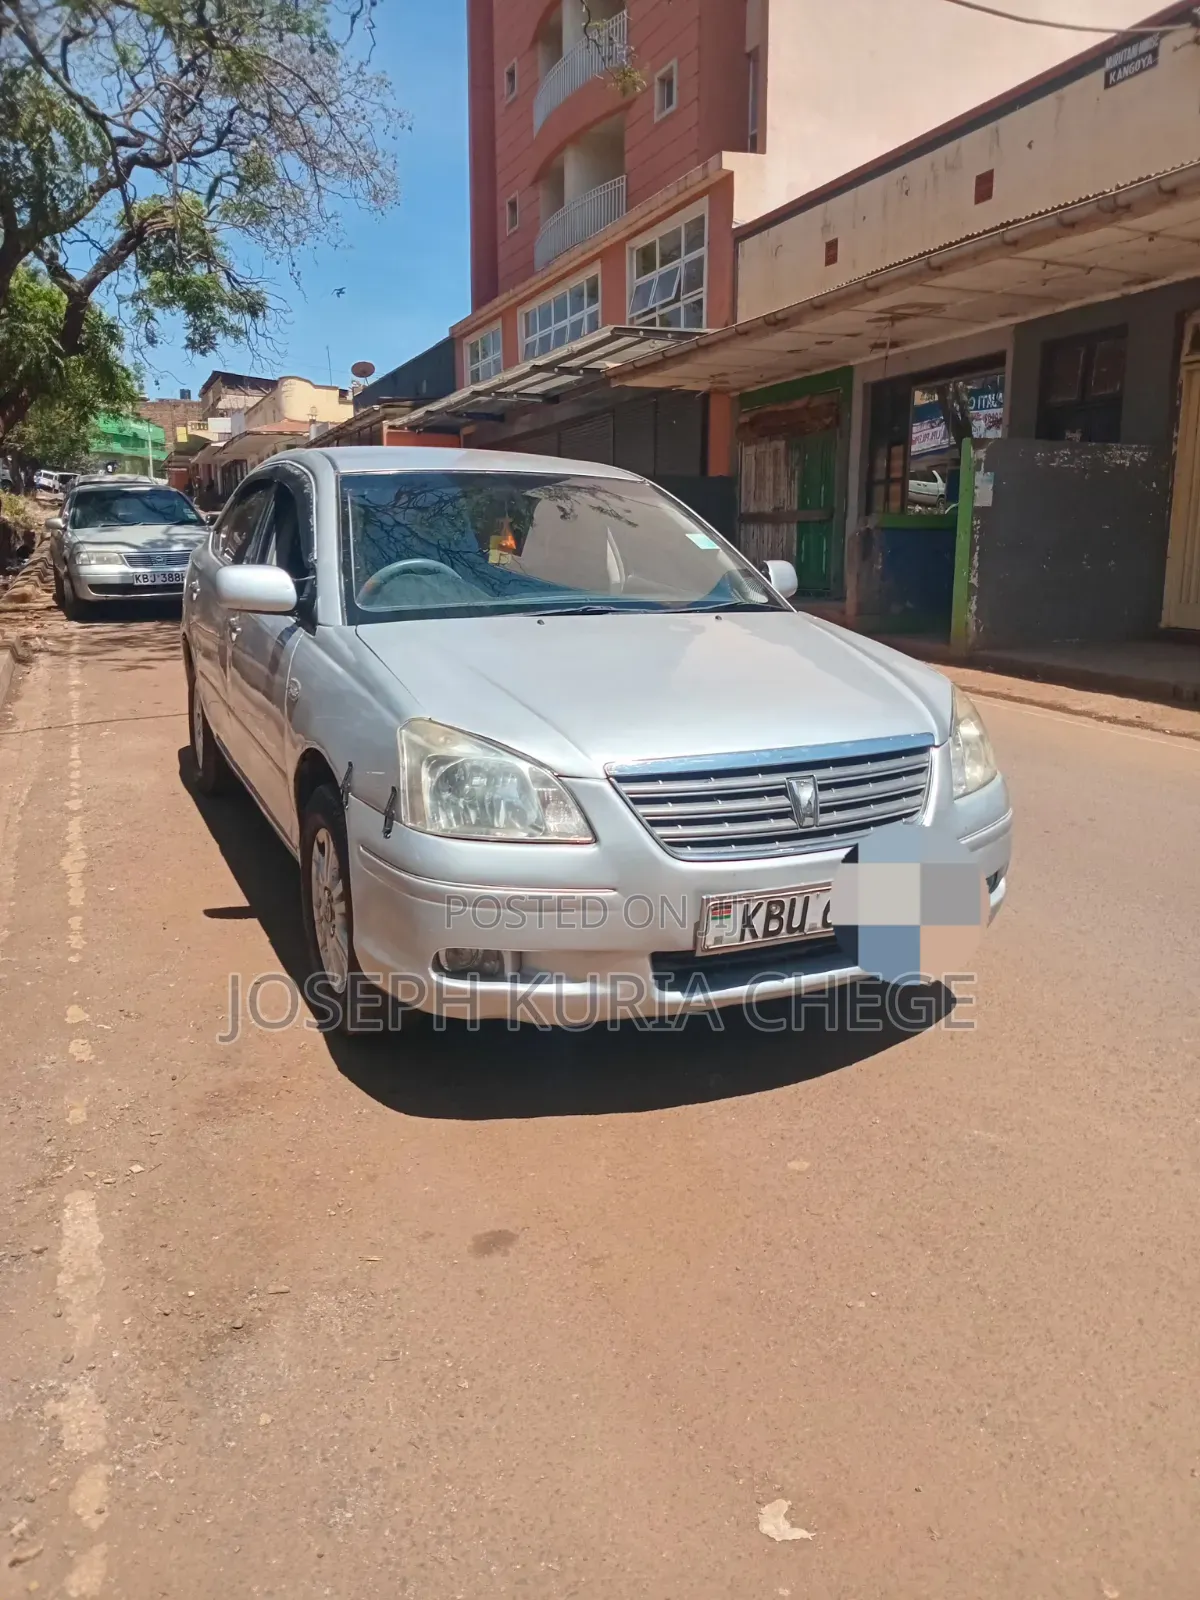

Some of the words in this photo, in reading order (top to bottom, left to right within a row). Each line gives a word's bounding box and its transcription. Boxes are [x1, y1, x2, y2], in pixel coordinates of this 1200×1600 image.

[1109, 54, 1153, 85] KANGOYA
[134, 574, 156, 584] KBJ
[739, 895, 810, 942] KBU
